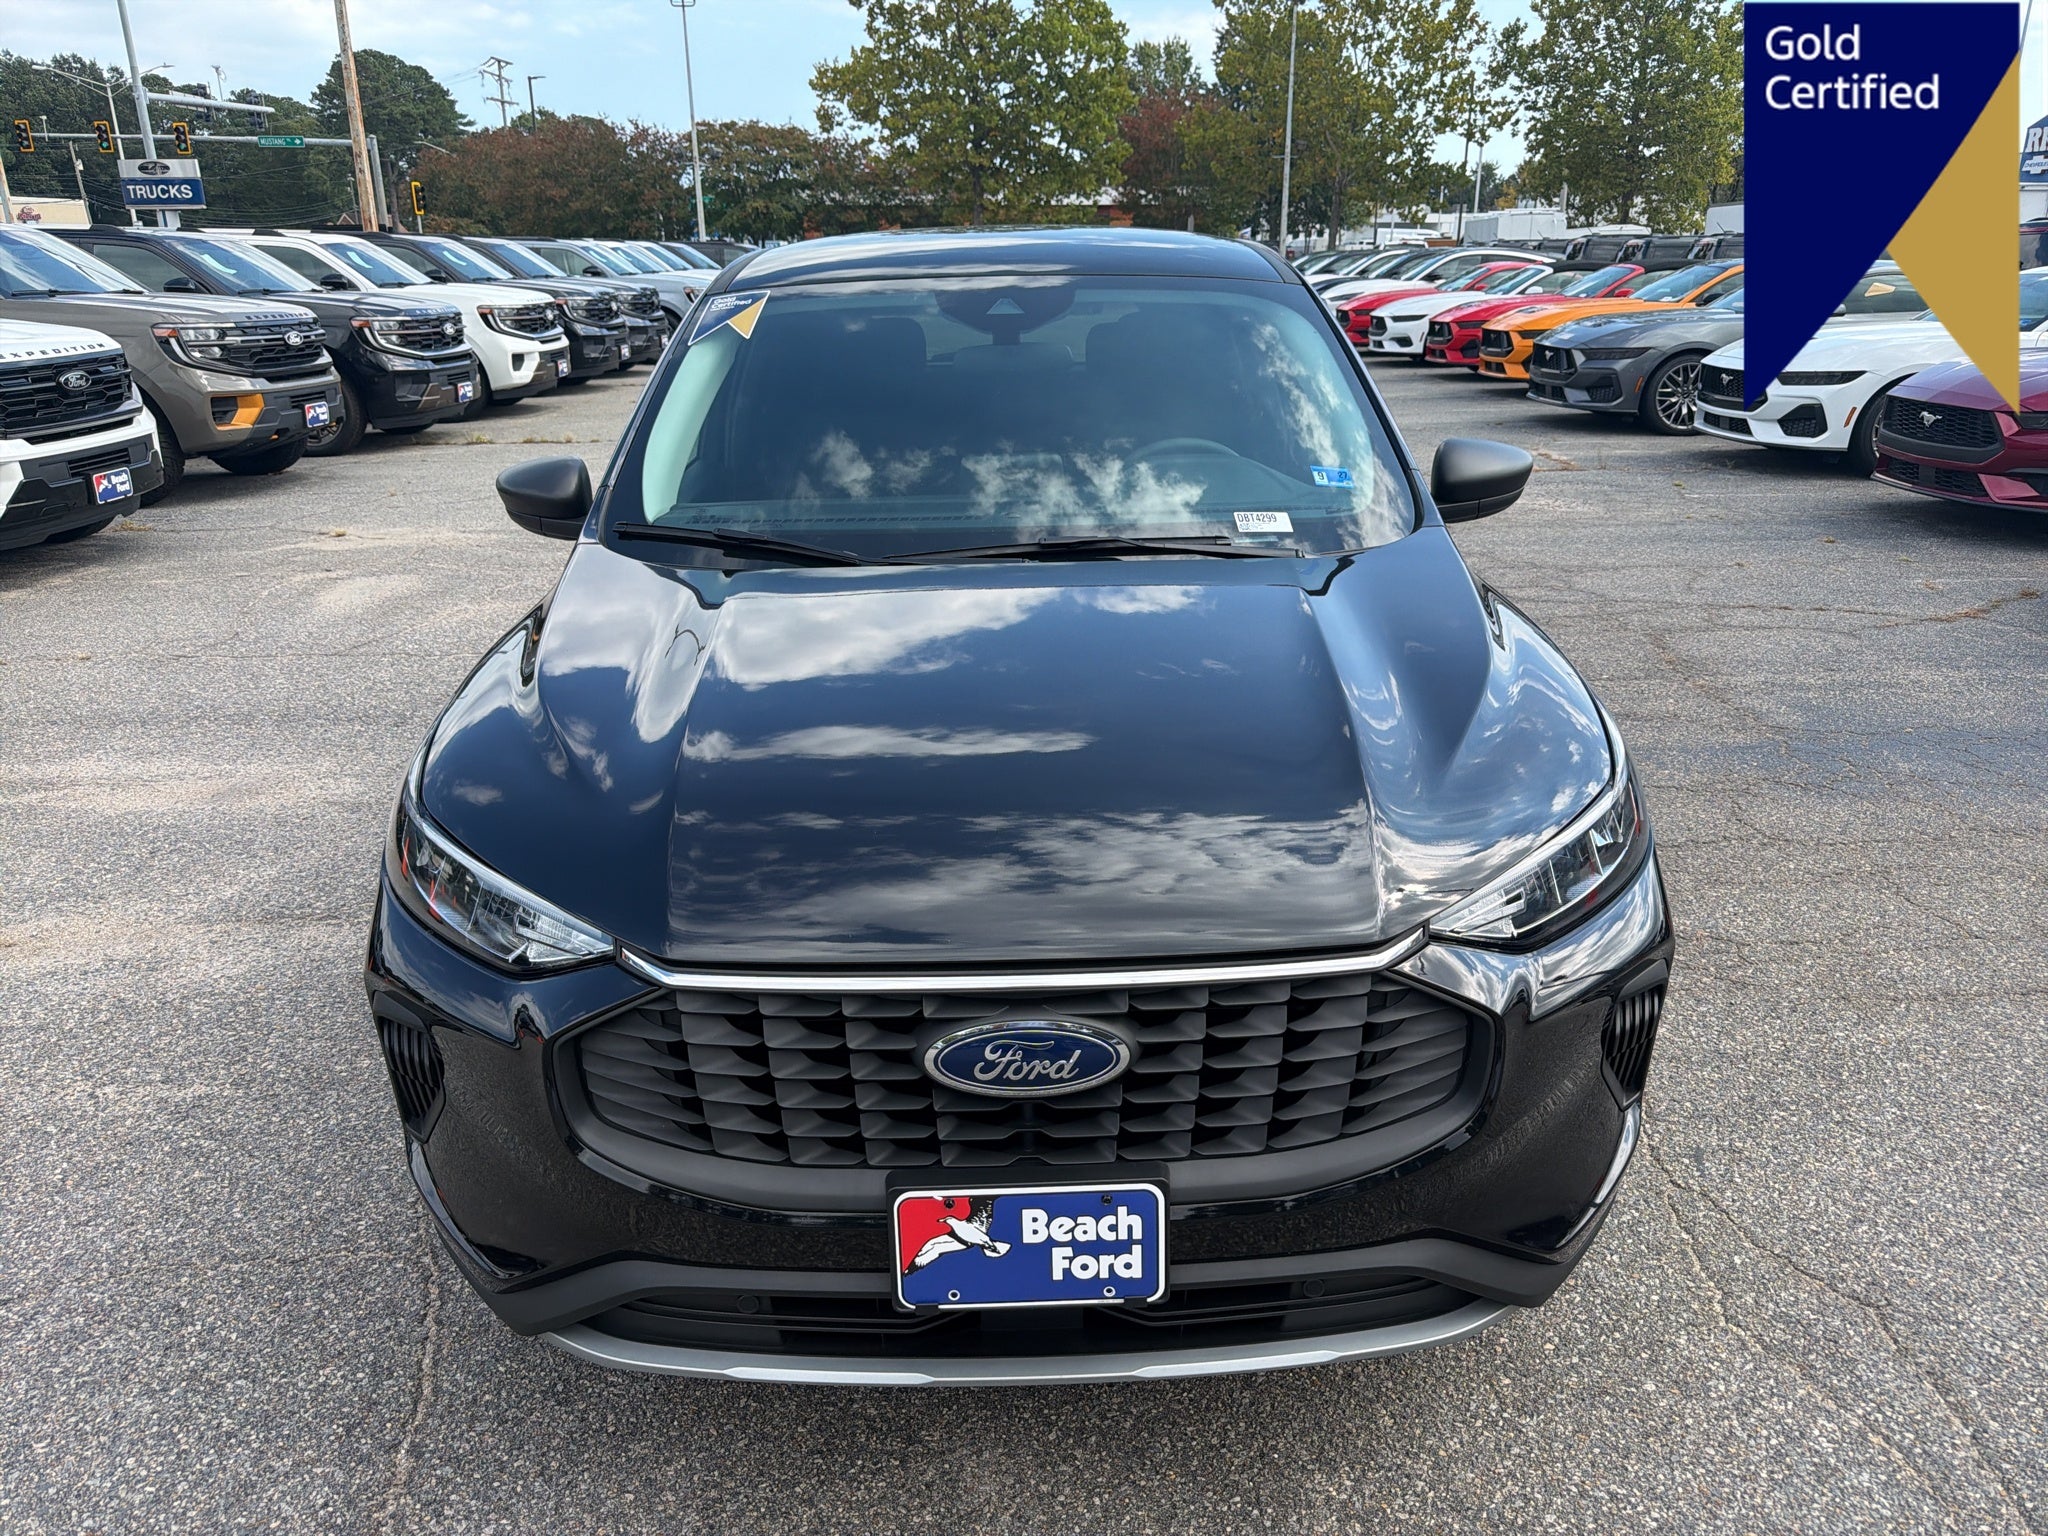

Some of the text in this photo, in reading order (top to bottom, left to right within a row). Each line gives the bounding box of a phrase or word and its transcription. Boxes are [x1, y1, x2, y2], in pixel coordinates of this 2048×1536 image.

[260, 137, 286, 146] MUSTANG
[126, 184, 194, 199] TRUCKS
[711, 299, 753, 309] Certified
[713, 296, 737, 304] Gold
[66, 374, 87, 388] Ford
[110, 472, 129, 484] Beach
[1317, 471, 1348, 481] 9 27
[116, 481, 130, 493] Ford
[973, 1039, 1082, 1081] Ford
[1021, 1205, 1143, 1244] Beach
[1051, 1244, 1143, 1281] Ford
